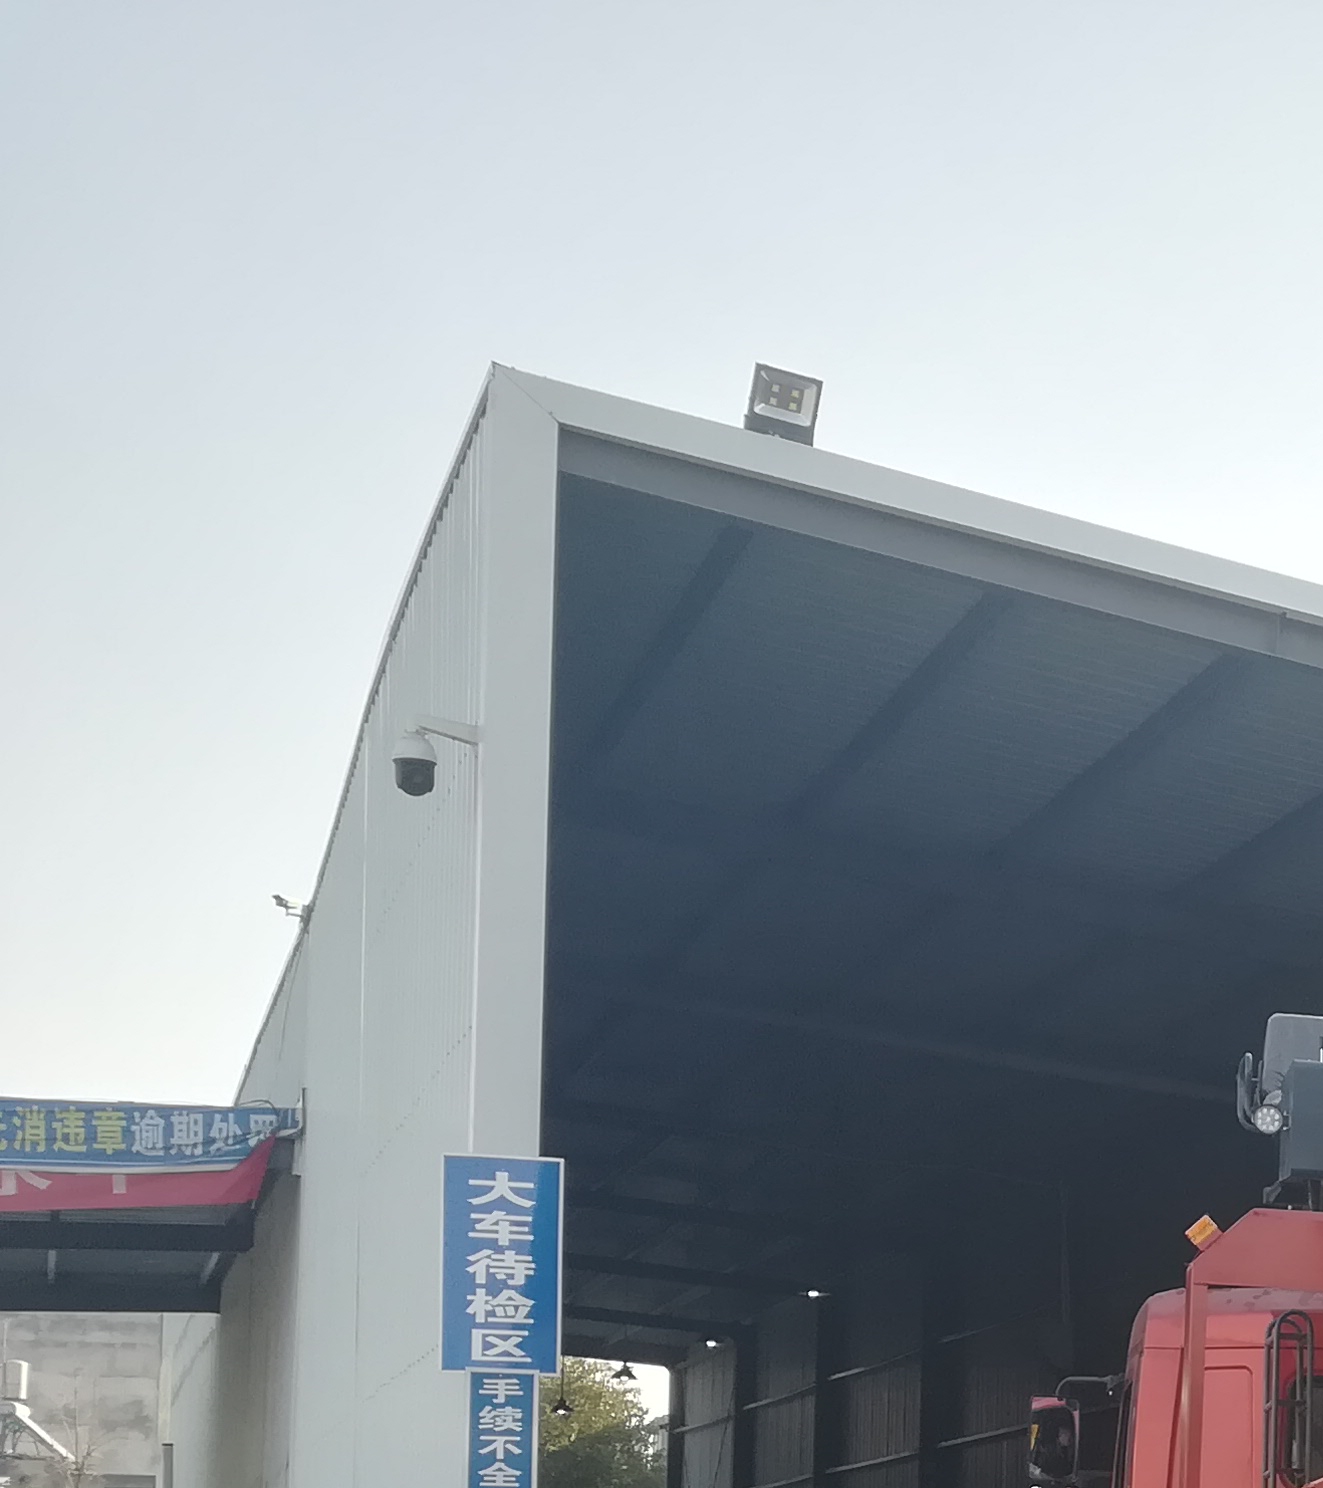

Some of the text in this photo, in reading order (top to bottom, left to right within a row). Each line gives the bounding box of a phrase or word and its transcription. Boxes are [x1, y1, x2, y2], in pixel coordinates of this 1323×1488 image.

[0, 1105, 278, 1155] 消违章逾期处
[465, 1171, 537, 1363] 大车待检区
[477, 1378, 524, 1488] 手续不全
